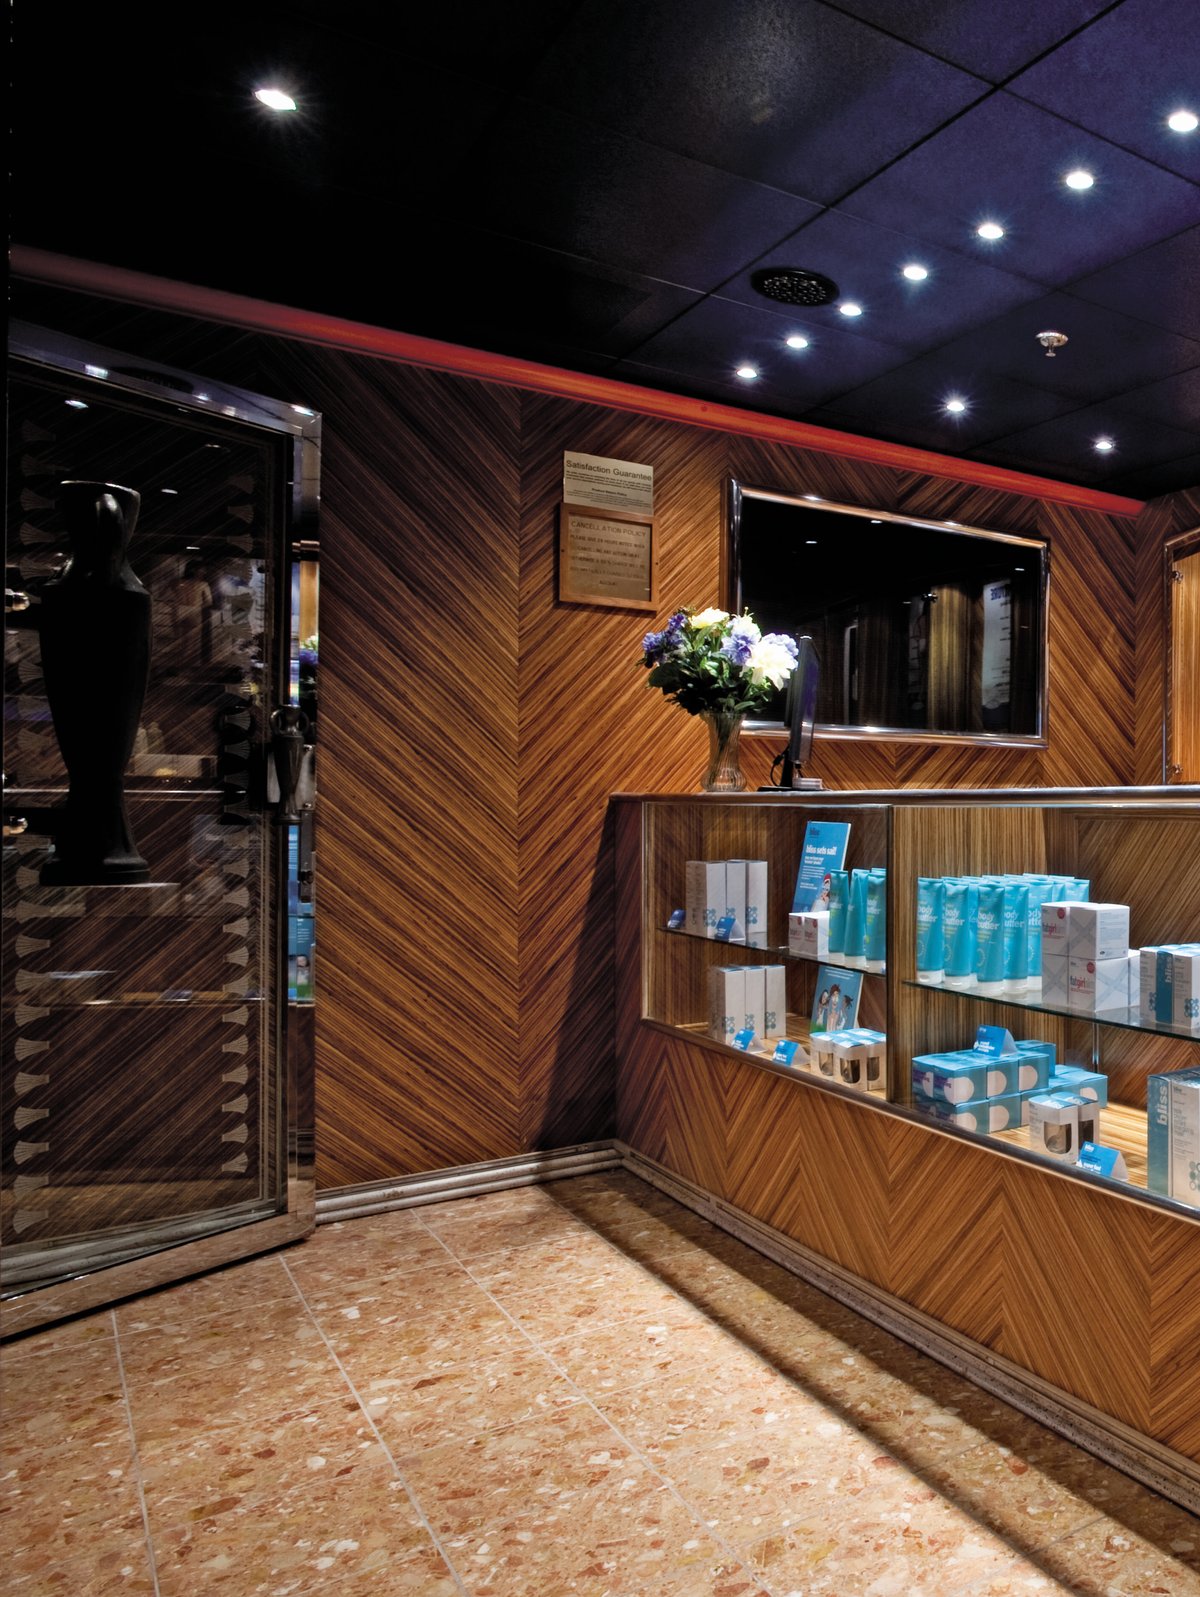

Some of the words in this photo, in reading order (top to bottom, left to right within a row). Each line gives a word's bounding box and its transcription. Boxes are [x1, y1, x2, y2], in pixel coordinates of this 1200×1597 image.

[566, 460, 610, 474] Satisfaction
[613, 468, 652, 481] Guarantee
[622, 528, 646, 537] POLICY
[1157, 1085, 1168, 1125] bliss
